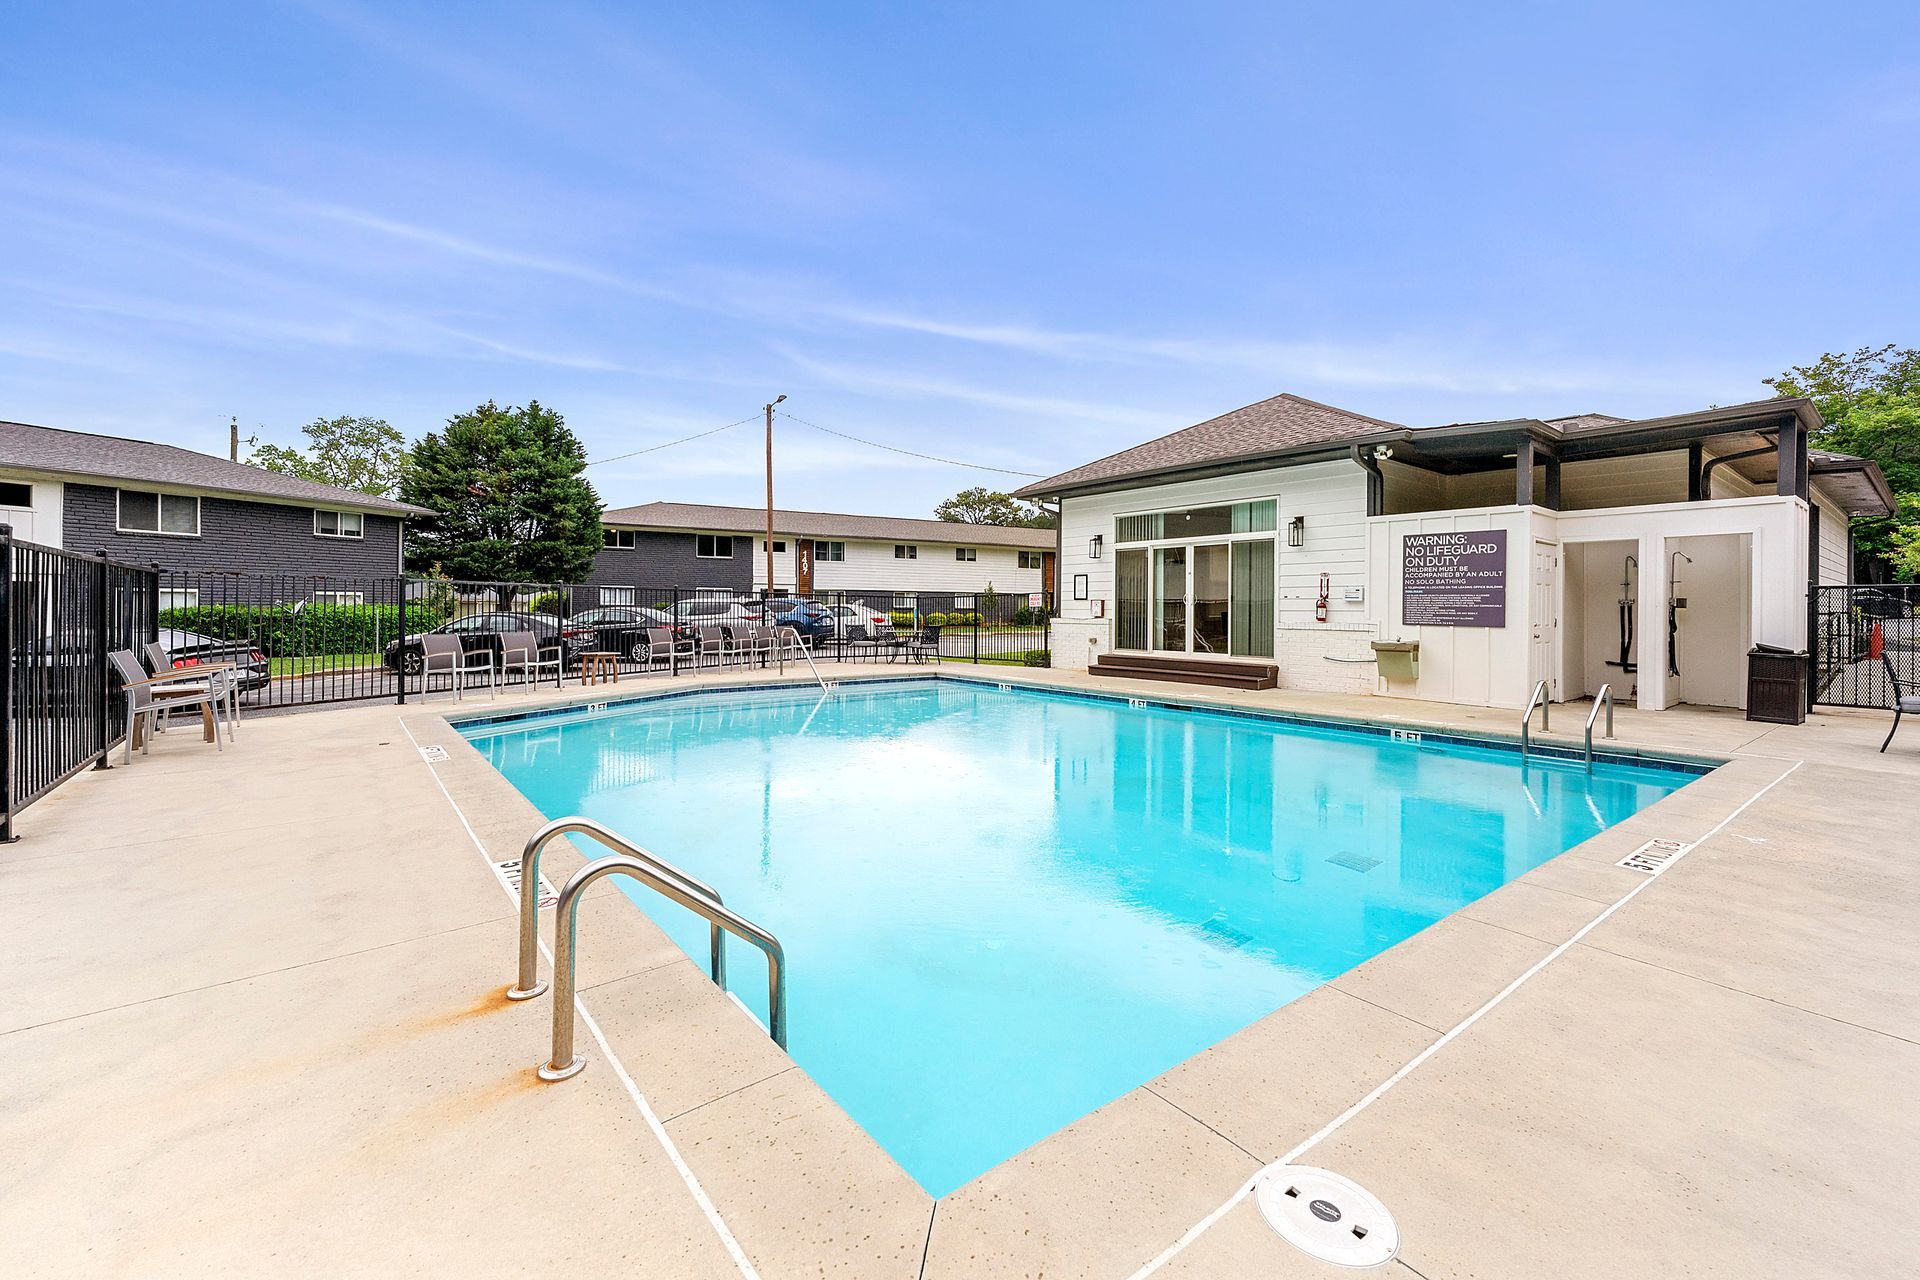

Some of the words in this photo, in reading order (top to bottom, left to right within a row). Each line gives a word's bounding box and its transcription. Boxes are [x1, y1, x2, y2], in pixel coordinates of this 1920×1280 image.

[1405, 535, 1467, 546] WARNING:
[1405, 546, 1424, 556] NO
[1426, 543, 1497, 556] LIFEGUARD
[801, 550, 809, 576] 1407
[1405, 557, 1423, 567] ON
[1426, 555, 1460, 566] DUTY
[1394, 731, 1402, 742] 5
[1406, 733, 1420, 744] FT
